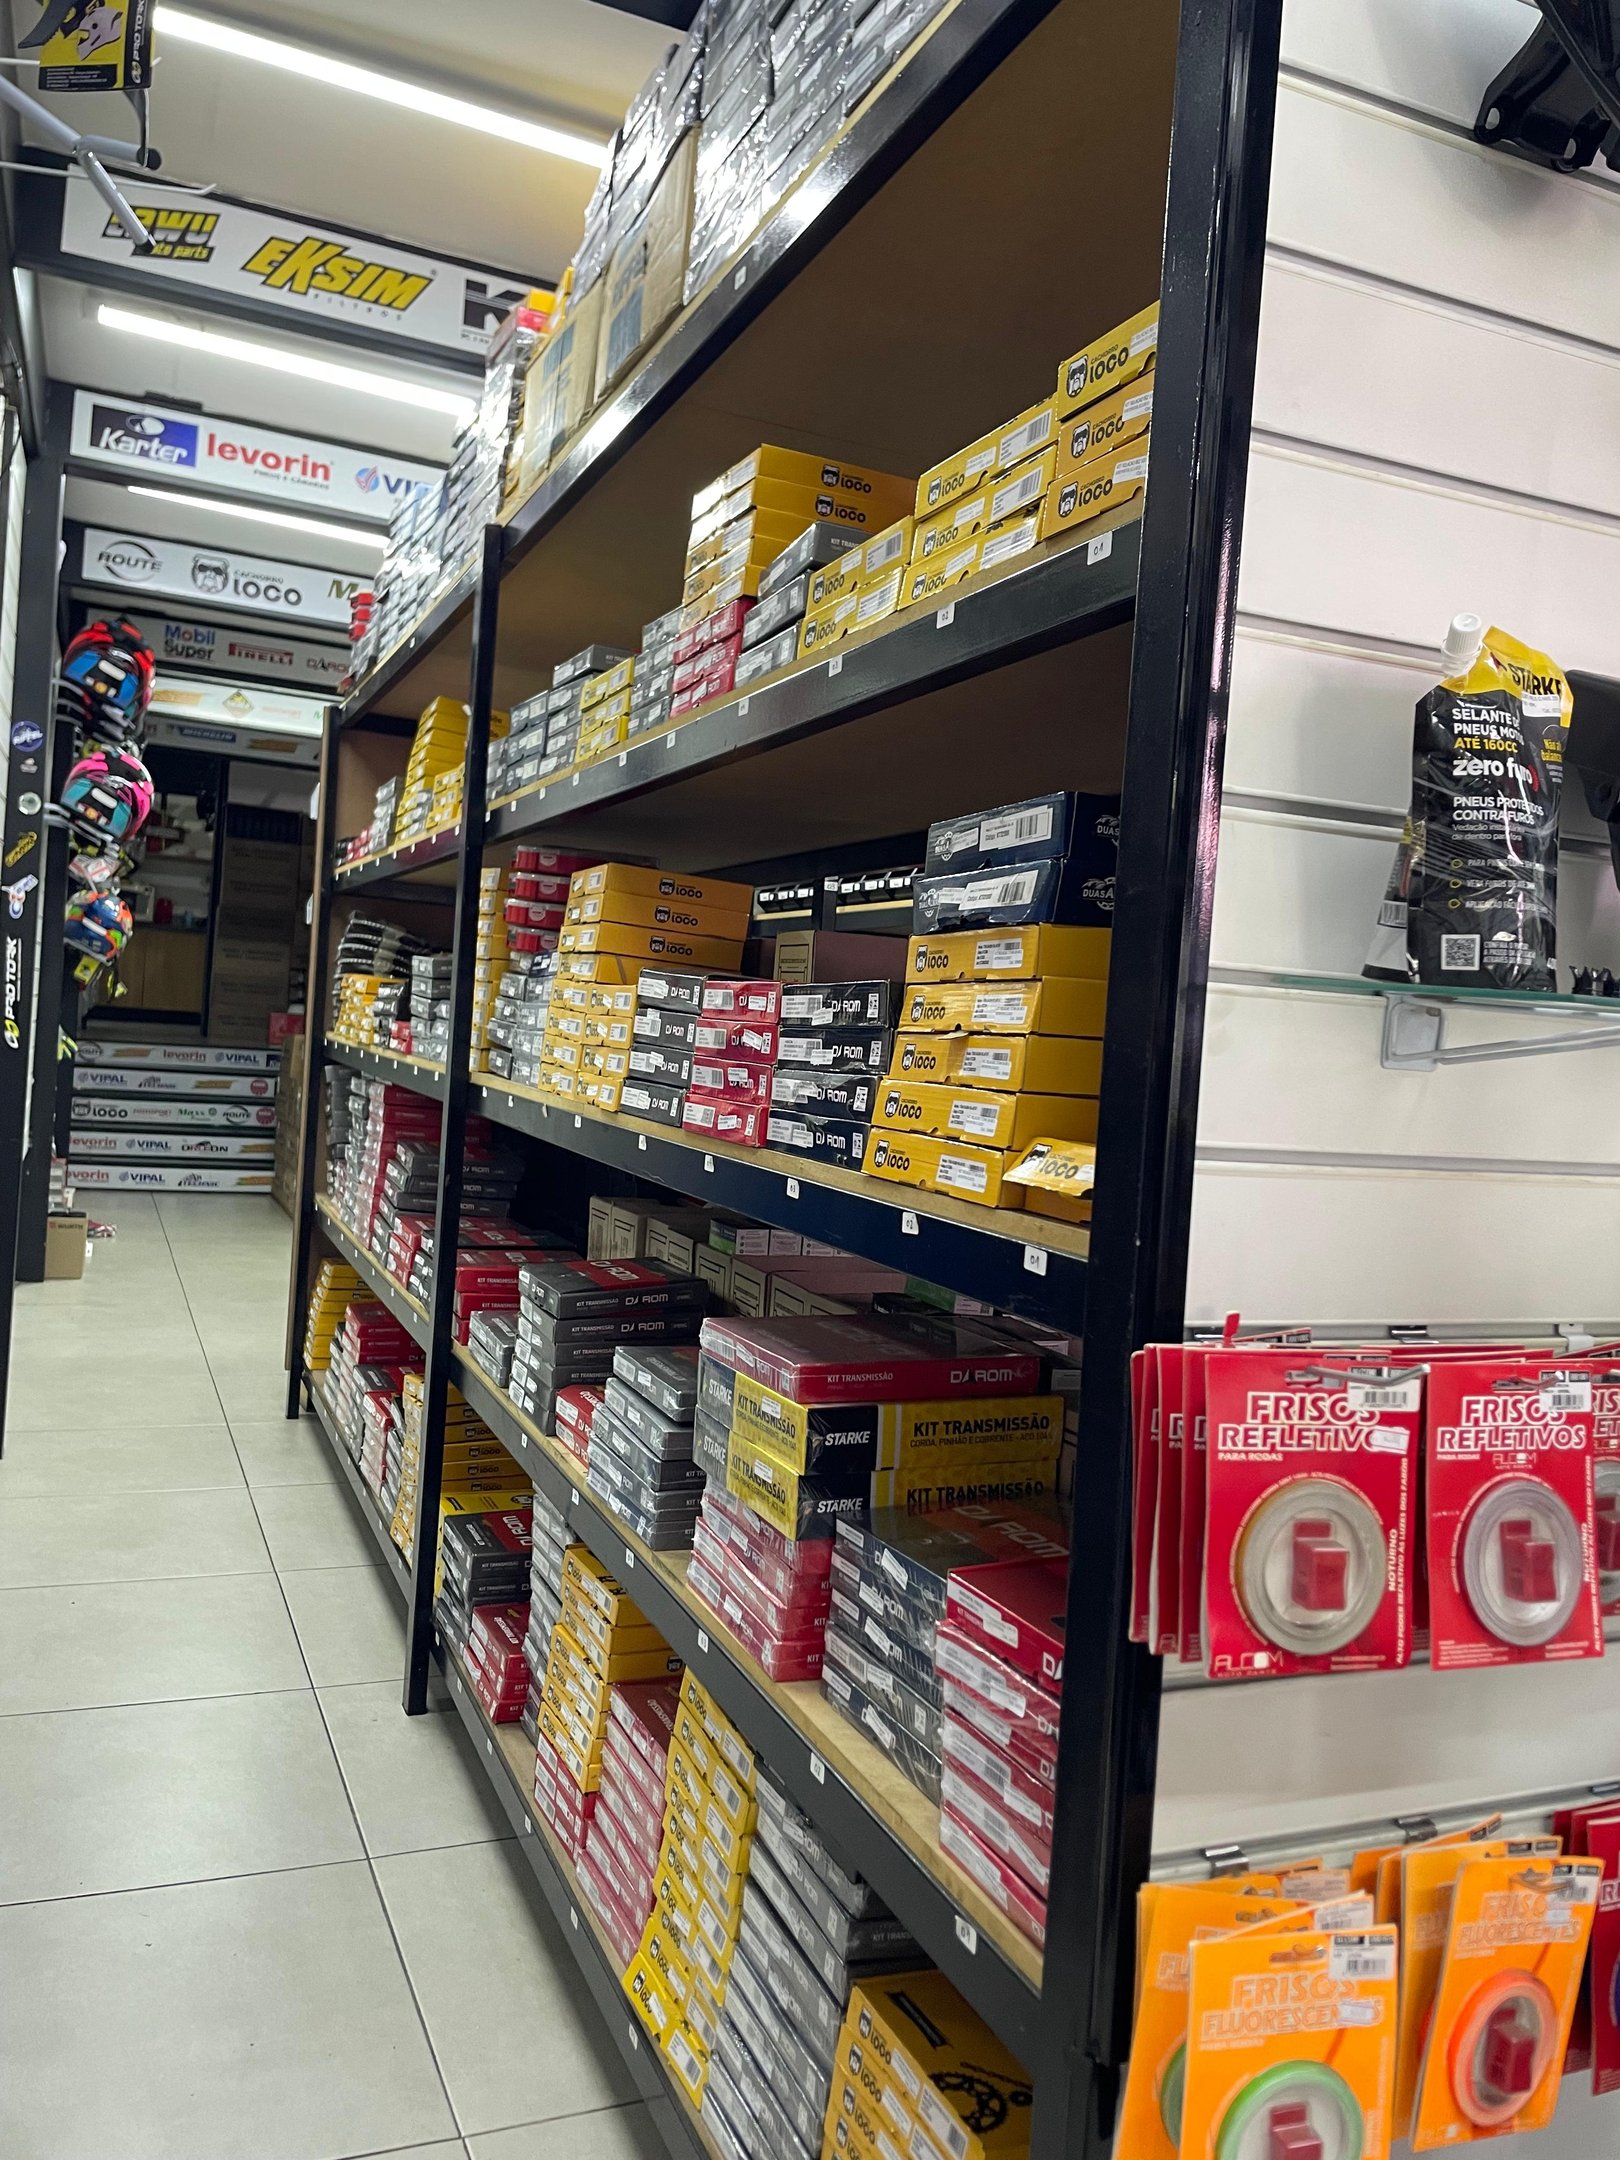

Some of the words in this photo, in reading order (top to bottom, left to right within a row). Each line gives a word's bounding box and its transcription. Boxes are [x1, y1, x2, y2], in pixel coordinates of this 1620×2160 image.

[242, 237, 433, 311] EKSIM
[99, 426, 188, 464] Karter
[206, 433, 331, 482] levorin
[97, 551, 163, 572] ROUTE
[164, 624, 216, 645] Mobil
[164, 639, 214, 660] Super
[228, 643, 294, 666] PIRELLI
[1452, 708, 1512, 725] SELANTE
[1453, 723, 1498, 736] PNEUS
[1454, 736, 1482, 749] ATÉ
[1483, 738, 1518, 753] 160CC
[1452, 759, 1505, 777] zero
[1453, 797, 1495, 807] PNEUS
[1453, 810, 1507, 821] CONTRA
[226, 1052, 259, 1063] VIPAL
[90, 1073, 127, 1083] VIPAL
[136, 1139, 171, 1150] VIPAL
[130, 1173, 165, 1183] VIPAL
[827, 1374, 848, 1383] KIT
[914, 1421, 939, 1437] KIT
[943, 1412, 1050, 1435] TRANSMISSÃO
[1436, 1424, 1586, 1452] REFLETIVOS
[907, 1488, 932, 1504] KIT
[936, 1477, 1044, 1503] TRANSMISSÃO
